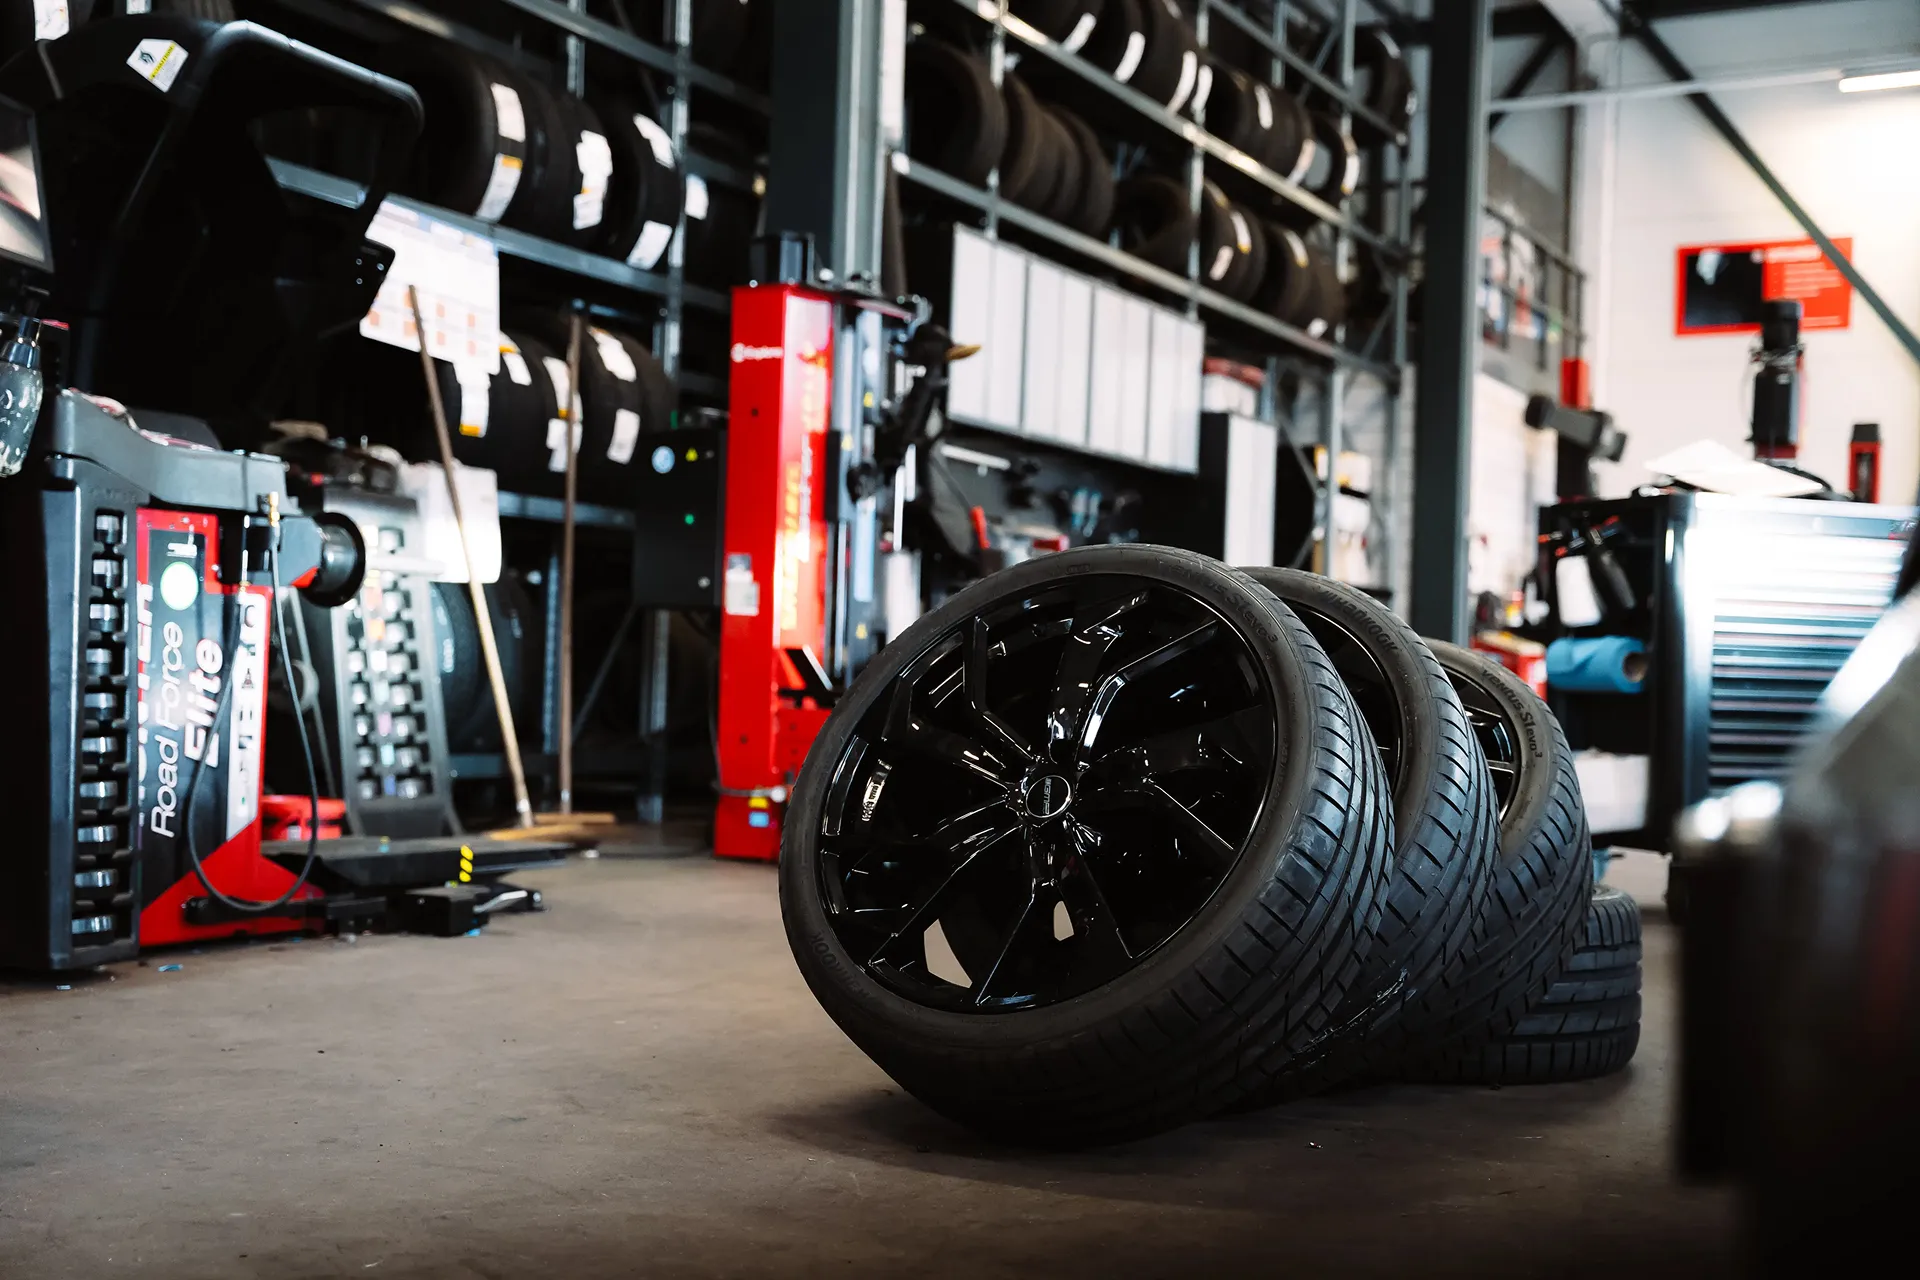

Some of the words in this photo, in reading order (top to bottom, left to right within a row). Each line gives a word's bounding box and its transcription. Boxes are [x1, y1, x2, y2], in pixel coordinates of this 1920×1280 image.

[154, 621, 185, 729] Force
[184, 637, 225, 768] Elite
[150, 734, 179, 838] Road
